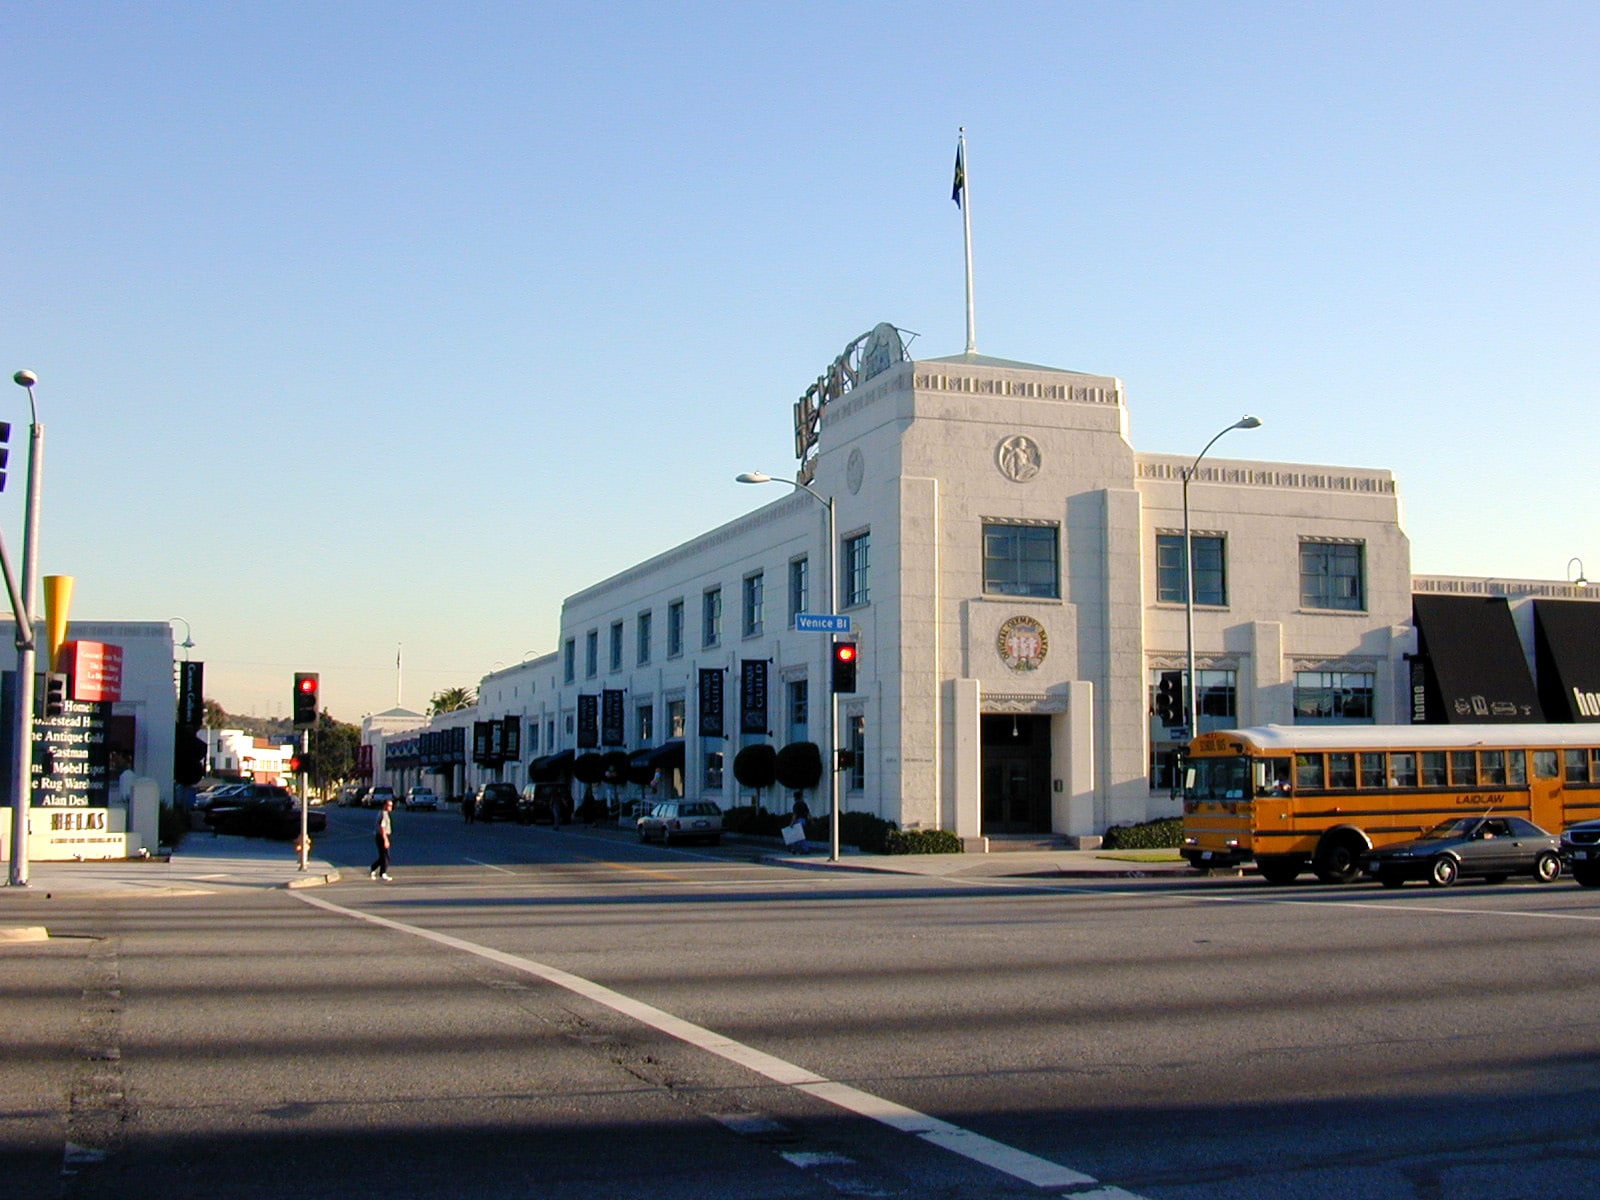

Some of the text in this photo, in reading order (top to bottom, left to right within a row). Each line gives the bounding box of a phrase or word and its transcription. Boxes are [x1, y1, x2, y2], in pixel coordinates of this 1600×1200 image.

[800, 617, 848, 629] Venice Bl
[712, 672, 720, 713] GUILD
[755, 664, 763, 708] GUILD
[1413, 686, 1425, 721] home
[1573, 687, 1600, 716] ho
[44, 731, 83, 745] Antique
[48, 746, 89, 758] Eastman
[41, 777, 63, 792] Rug
[42, 794, 66, 806] Alan
[1456, 794, 1505, 804] LAIDLAW
